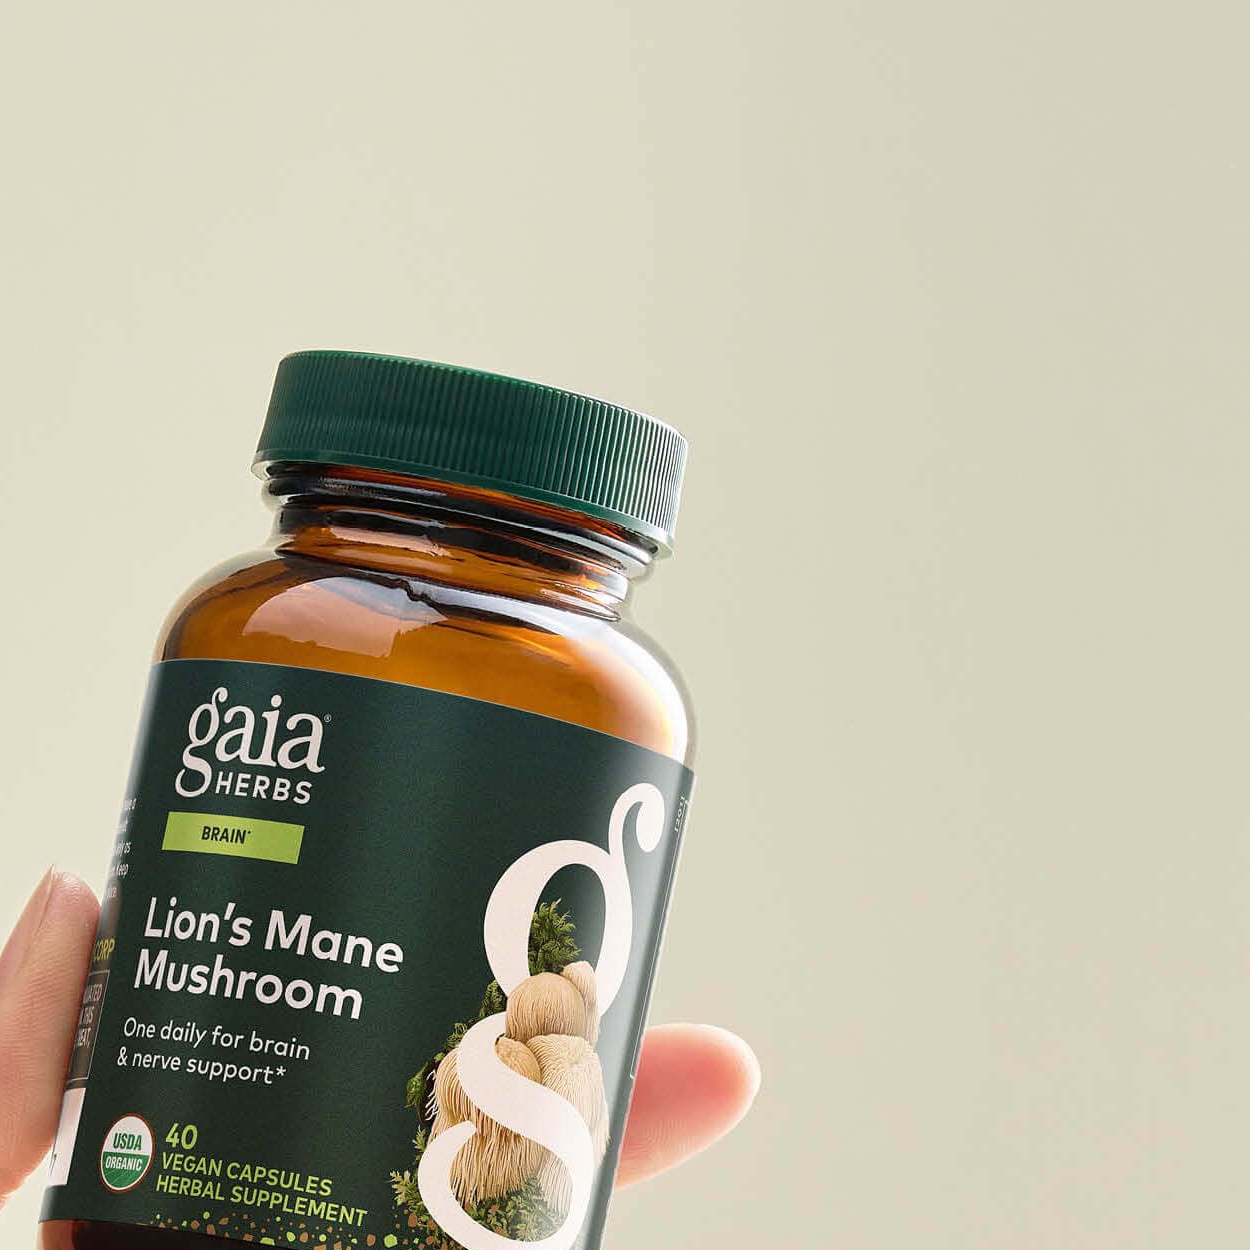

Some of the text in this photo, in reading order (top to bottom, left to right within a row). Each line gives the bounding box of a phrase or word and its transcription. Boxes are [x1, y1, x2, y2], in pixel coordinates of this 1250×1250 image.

[175, 687, 326, 798] gaia
[215, 771, 313, 805] HERBS
[144, 896, 404, 973] Lion's Mane
[134, 948, 363, 1020] Mushroom
[117, 1045, 129, 1067] &
[132, 1052, 182, 1071] nerve
[123, 1016, 311, 1060] One daily for brain
[112, 1132, 143, 1151] USDA
[165, 1122, 198, 1150] 40
[104, 1155, 143, 1172] ORGANIC
[162, 1151, 333, 1197] VEGAN CAPSULES
[156, 1174, 368, 1227] HERBAL SUPPLEMENT
